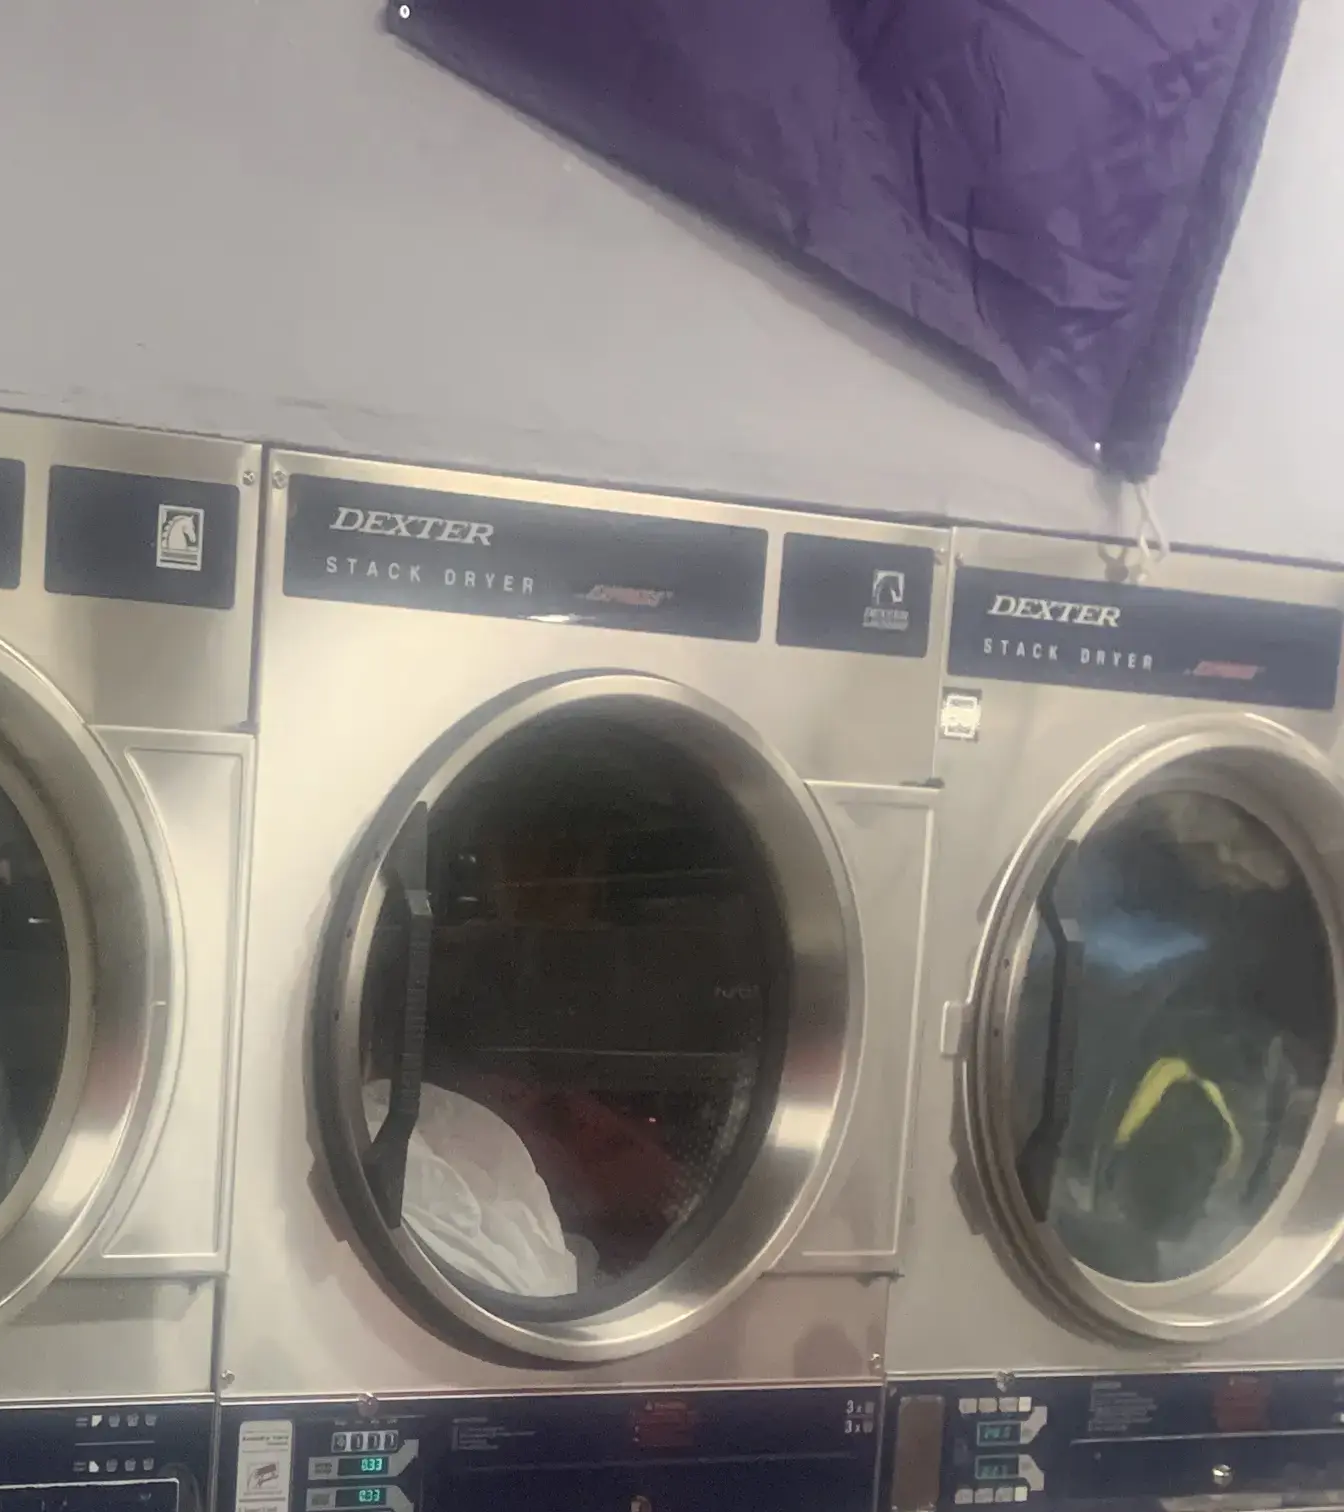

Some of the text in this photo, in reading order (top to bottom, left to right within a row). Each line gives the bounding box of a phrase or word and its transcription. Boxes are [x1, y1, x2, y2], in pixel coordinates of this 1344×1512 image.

[329, 506, 494, 546] DEXTER
[326, 556, 534, 594] STACK DRYER
[986, 595, 1121, 627] DEXTER
[983, 637, 1153, 671] STACK DRYER
